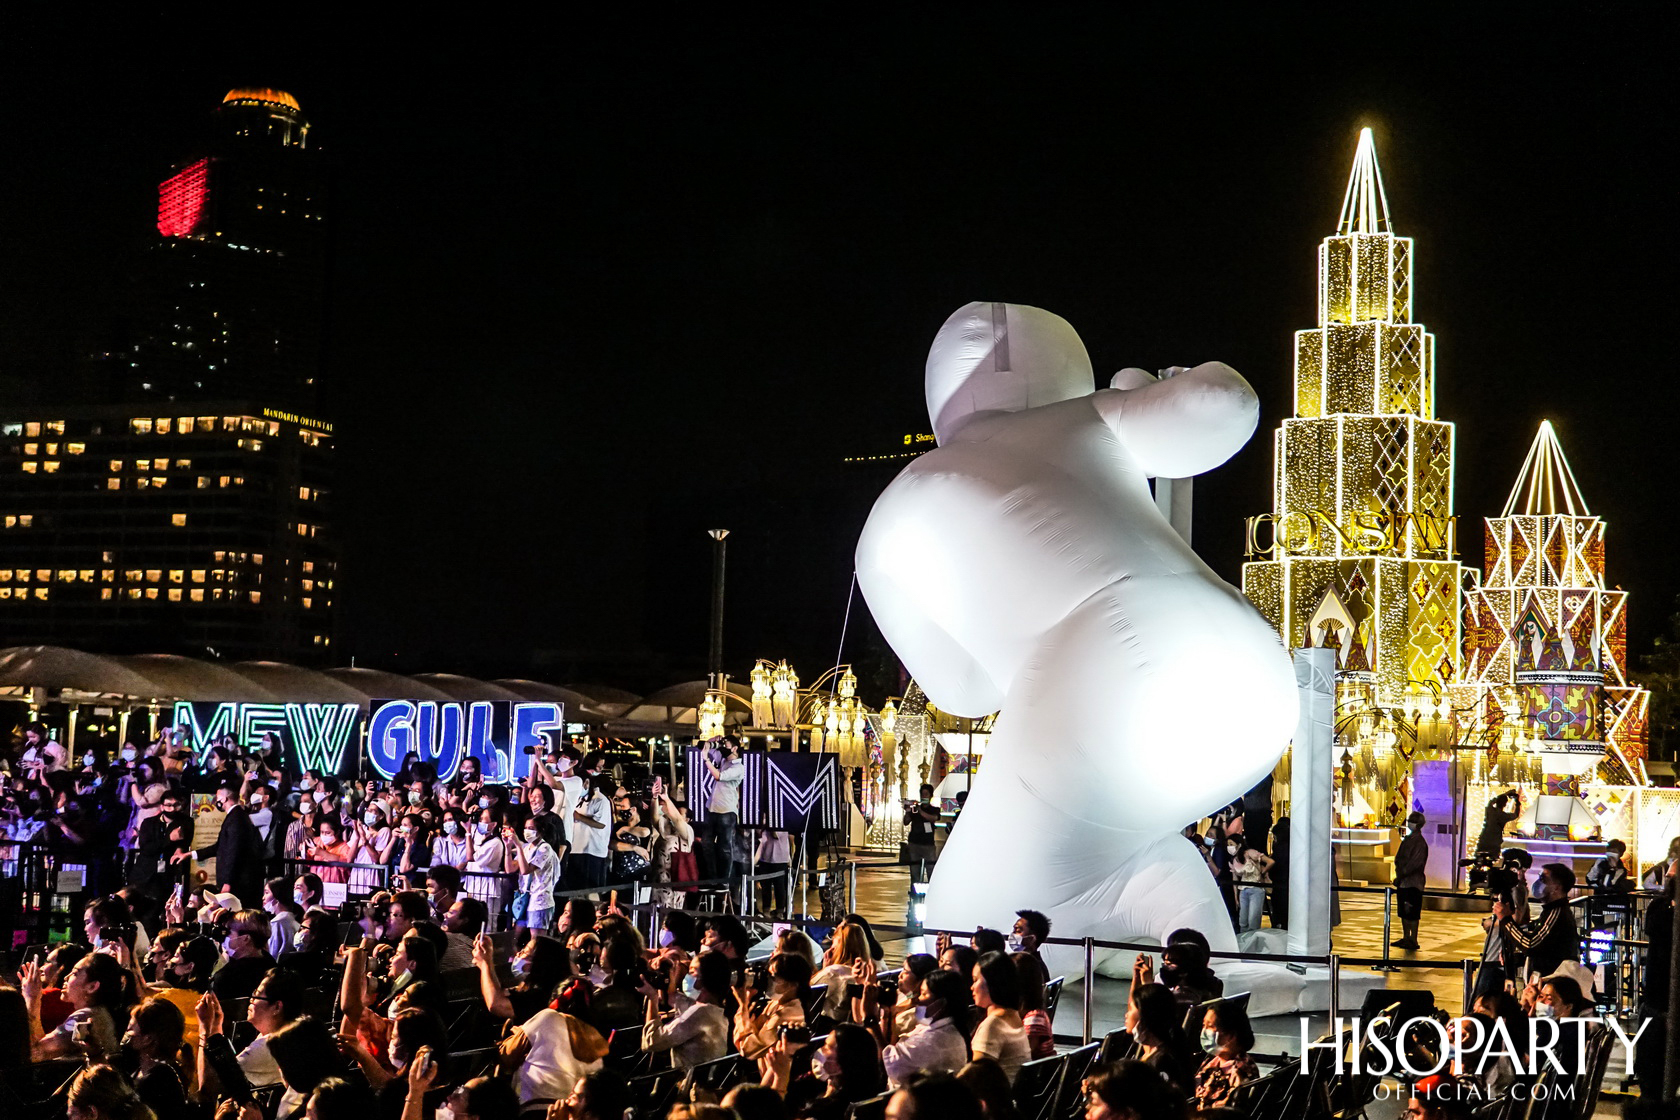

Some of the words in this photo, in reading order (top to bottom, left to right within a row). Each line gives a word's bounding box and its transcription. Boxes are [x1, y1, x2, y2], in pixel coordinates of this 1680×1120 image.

[1243, 510, 1460, 556] ICONSIAM
[173, 701, 360, 777] MEW
[367, 700, 562, 787] GULF
